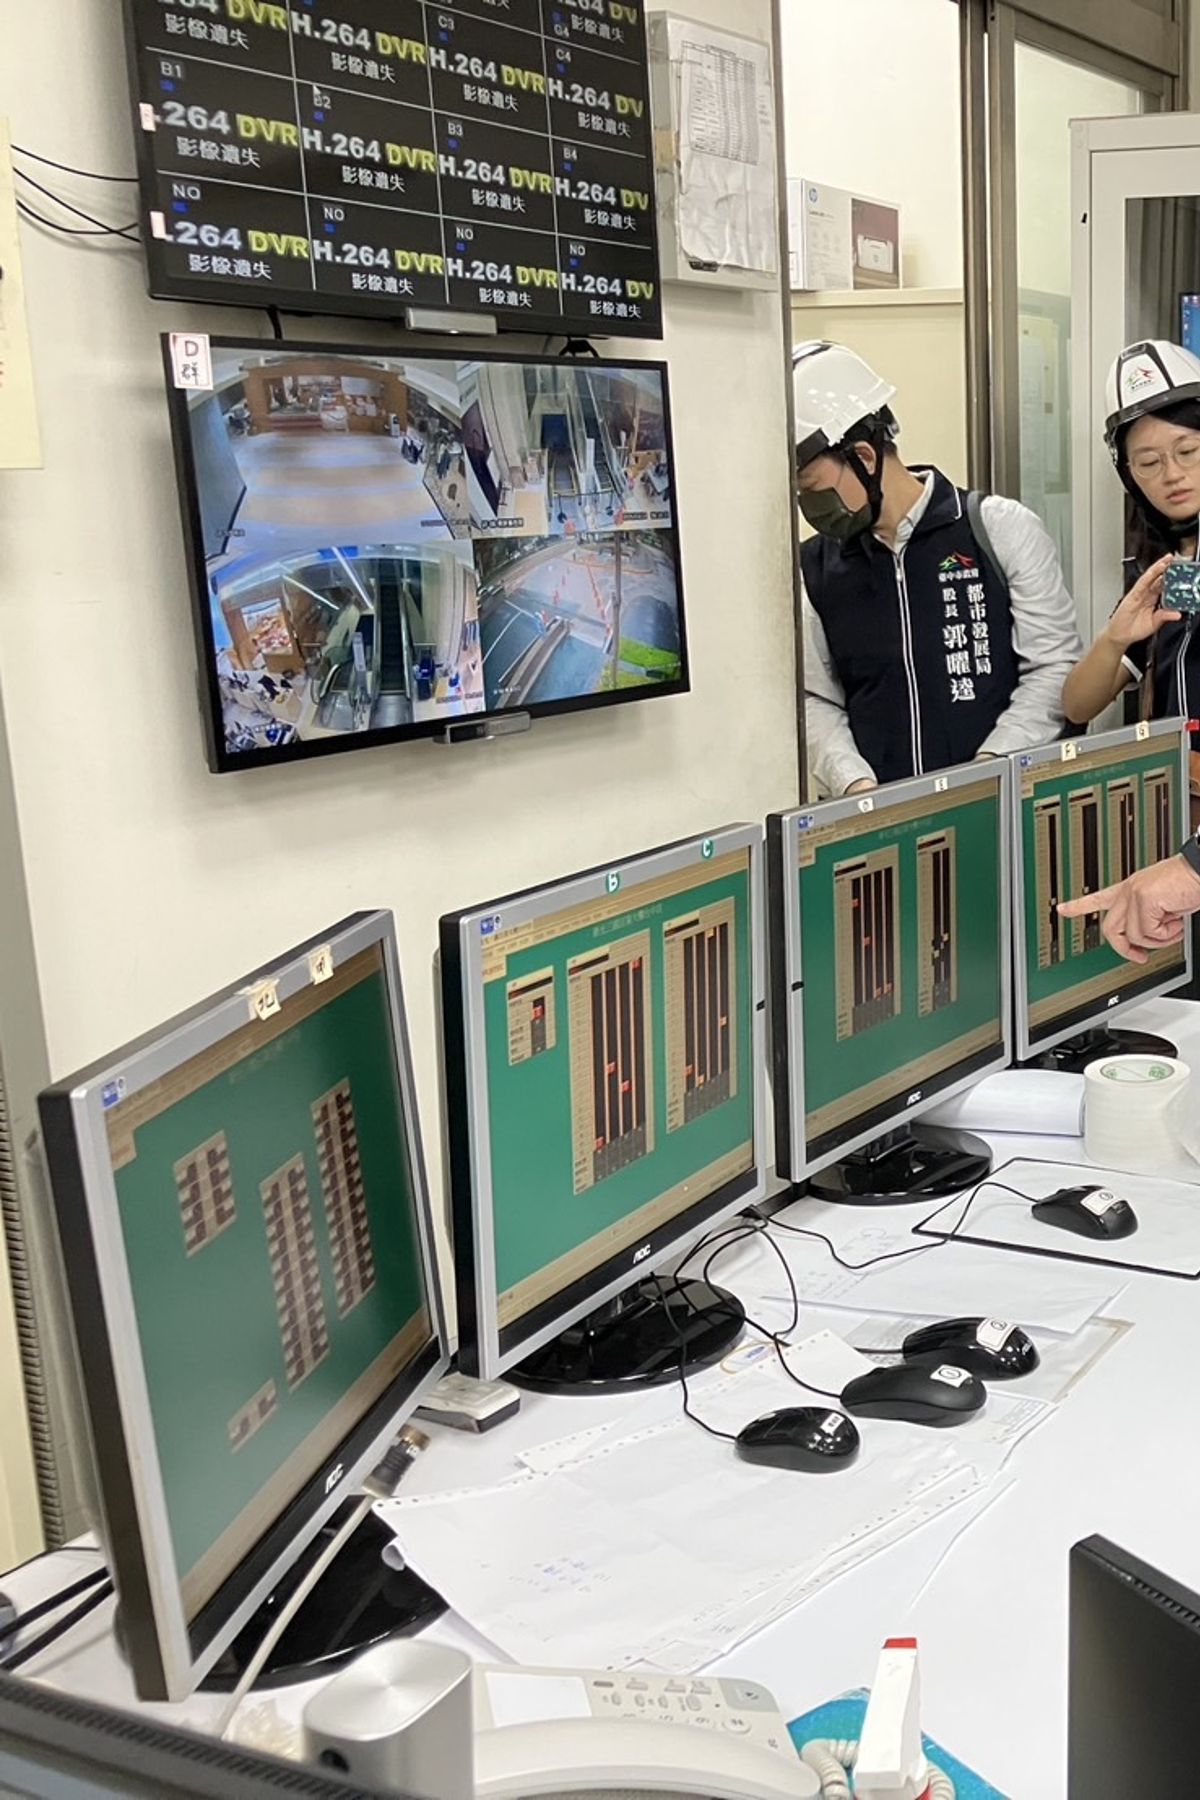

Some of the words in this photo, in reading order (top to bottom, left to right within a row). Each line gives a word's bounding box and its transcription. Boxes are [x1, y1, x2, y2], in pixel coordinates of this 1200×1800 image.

[292, 11, 371, 50] H.264
[375, 31, 426, 64] DVR
[160, 61, 182, 78] B1
[430, 47, 498, 82] H.264
[501, 65, 545, 94] DVR
[548, 78, 611, 110] H.264
[235, 114, 298, 147] DVR
[448, 122, 463, 137] B3
[302, 127, 381, 162] H.264
[385, 143, 435, 172] DVR
[439, 154, 505, 186] H.264
[509, 167, 551, 193] DVR
[172, 183, 201, 200] NO
[555, 177, 617, 206] H.264
[323, 207, 345, 221] NO
[247, 230, 309, 259] DVR
[455, 227, 474, 240] NO
[312, 239, 391, 269] H.264
[394, 250, 443, 276] DVR
[569, 243, 586, 256] NO
[447, 258, 512, 284] H.264
[516, 265, 557, 289] DVR
[561, 272, 622, 297] H.264
[184, 340, 199, 357] D
[966, 583, 992, 676] 都市發展局
[702, 839, 713, 858] C
[607, 871, 618, 893] B
